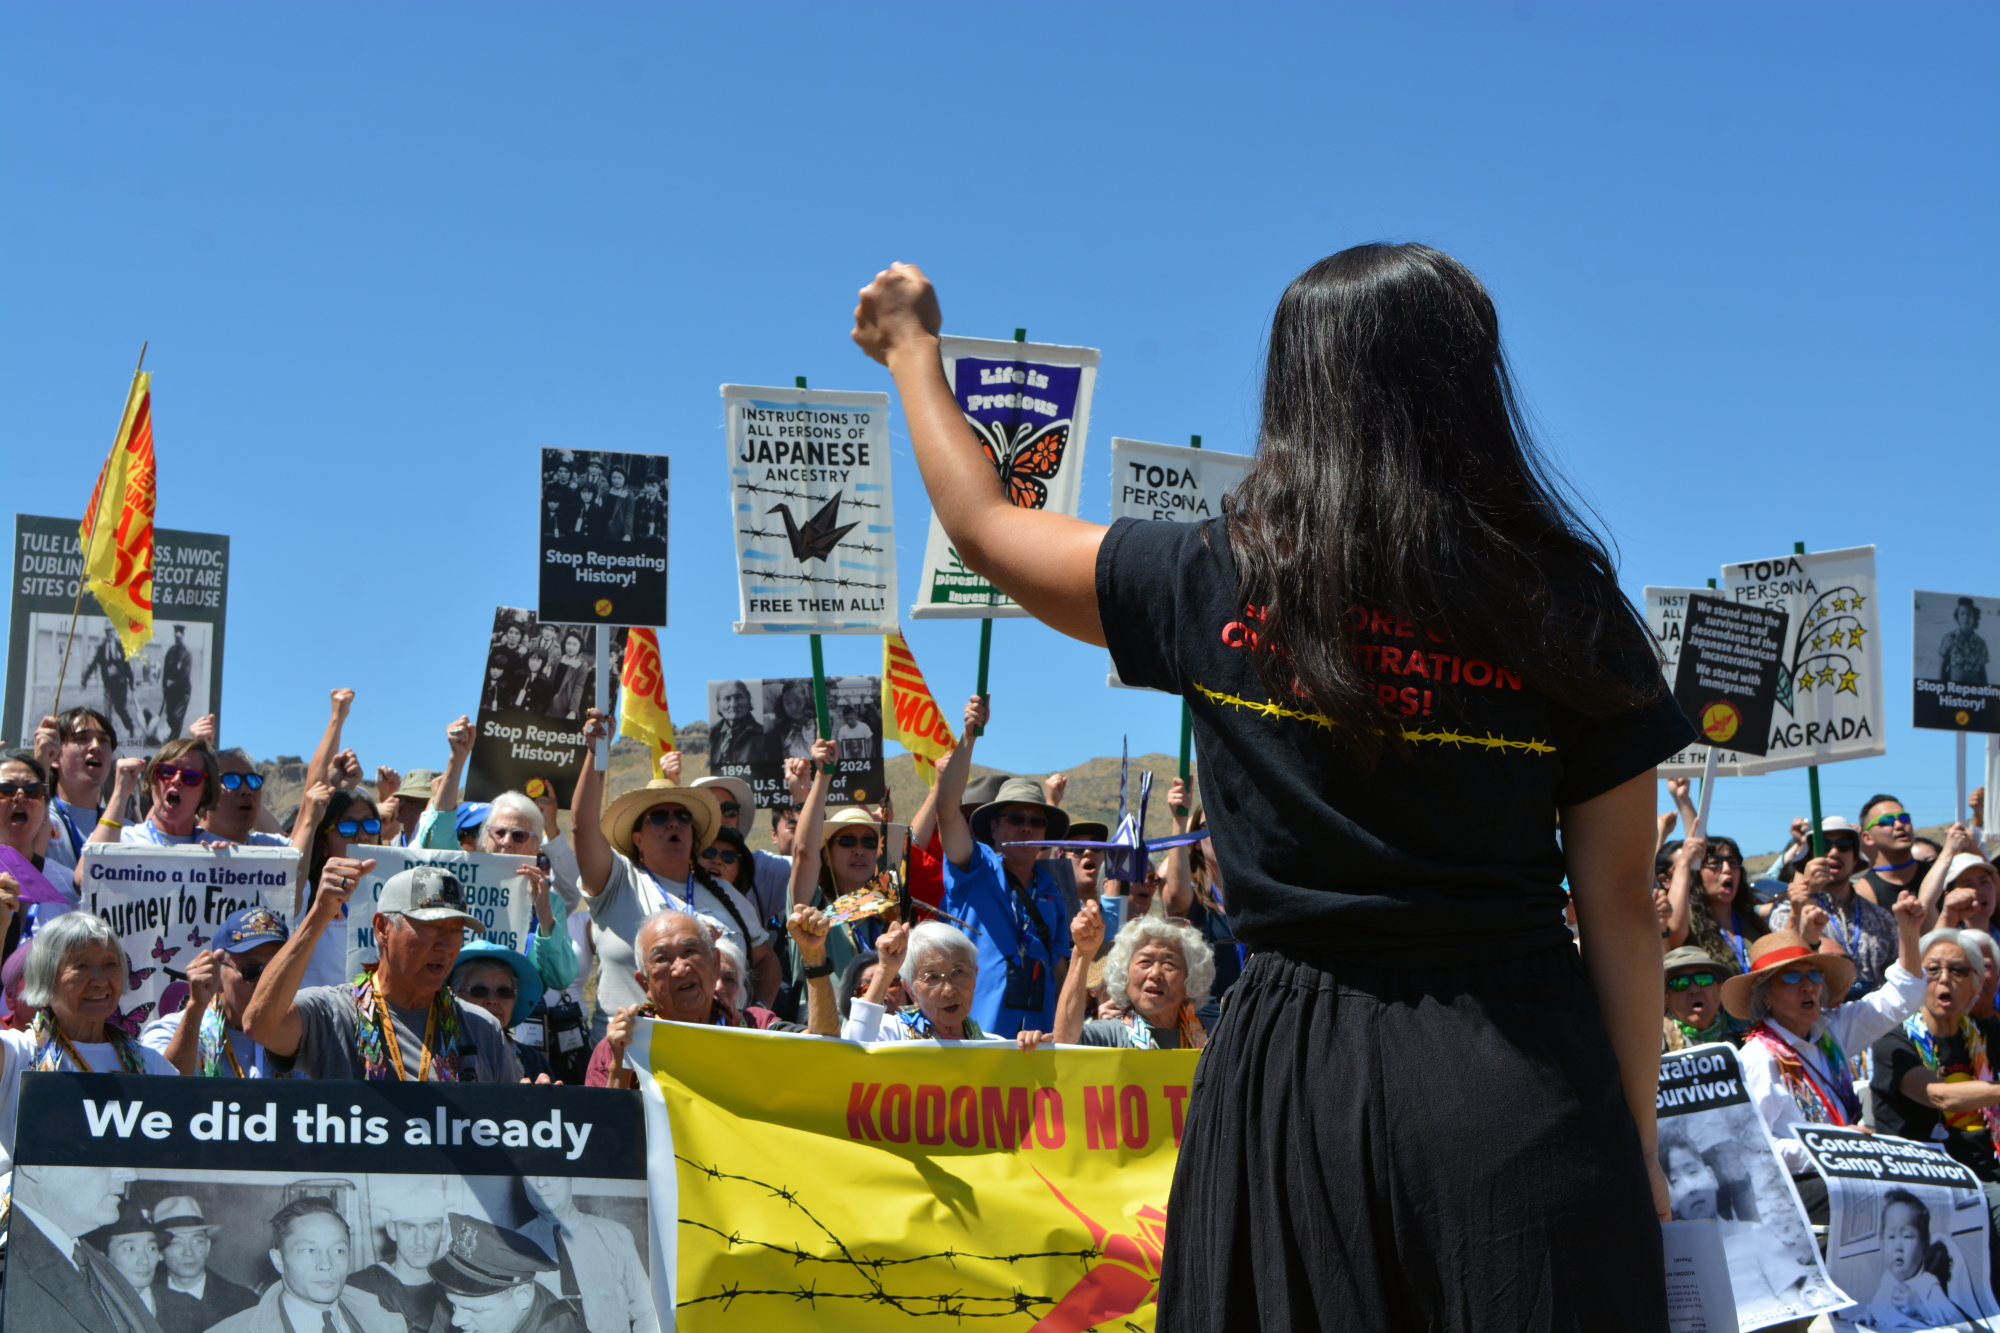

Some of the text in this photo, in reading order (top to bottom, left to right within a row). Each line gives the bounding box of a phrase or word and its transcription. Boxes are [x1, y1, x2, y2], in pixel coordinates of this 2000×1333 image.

[980, 366, 1049, 390] Life is
[967, 392, 1059, 417] Precious
[742, 408, 870, 425] INSTRUCTIONS TO
[747, 424, 866, 439] ALL PERSONS OF
[740, 439, 870, 466] JAPANESE
[765, 468, 850, 483] ANCESTRY
[1130, 462, 1197, 489] TODA
[1123, 486, 1210, 516] PERSONA
[21, 532, 60, 552] TULE
[177, 547, 224, 570] NWDC,
[546, 550, 666, 572] Stop Repeating
[1738, 557, 1803, 582] TODA
[21, 577, 64, 596] SITES
[194, 569, 222, 587] ARE
[576, 568, 636, 588] History!
[935, 574, 978, 586] Divest
[162, 587, 173, 604] &
[175, 588, 220, 607] ABUSE
[948, 590, 991, 604] Invest
[992, 593, 1006, 604] in
[1735, 578, 1818, 603] PERSONA
[750, 597, 885, 612] FREE THEM ALL!
[1663, 609, 1682, 618] ALL
[1697, 601, 1712, 614] We
[1713, 606, 1740, 619] stand
[1742, 611, 1762, 624] with
[1764, 615, 1780, 628] the
[1345, 604, 1415, 638] ORE
[1705, 616, 1768, 636] survivors and
[1691, 623, 1749, 644] descendants
[1750, 636, 1761, 646] of
[1762, 638, 1778, 650] the
[1688, 635, 1732, 652] Japanese
[1733, 644, 1776, 662] American
[1700, 648, 1763, 670] incarceration.
[1696, 663, 1761, 686] We stand with
[1699, 676, 1756, 696] immigrants.
[1916, 680, 1946, 695] Stop
[1939, 694, 1986, 712] History!
[484, 721, 588, 746] Stop Repeati
[1770, 715, 1872, 750] AGRADA
[511, 743, 575, 767] History!
[1689, 753, 1725, 763] THM
[721, 765, 751, 776] 1894
[840, 761, 871, 772] 2024
[754, 779, 780, 791] U.S.
[832, 776, 846, 788] of
[90, 864, 167, 882] Camino
[172, 871, 182, 882] a
[190, 868, 206, 884] la
[178, 884, 197, 925] to
[846, 1081, 1066, 1151] KODOMO
[1084, 1084, 1150, 1150] NO
[83, 1098, 593, 1160] We did this already
[1805, 1132, 1950, 1163] Concentration
[1818, 1152, 1967, 1180] Camp Survivor
